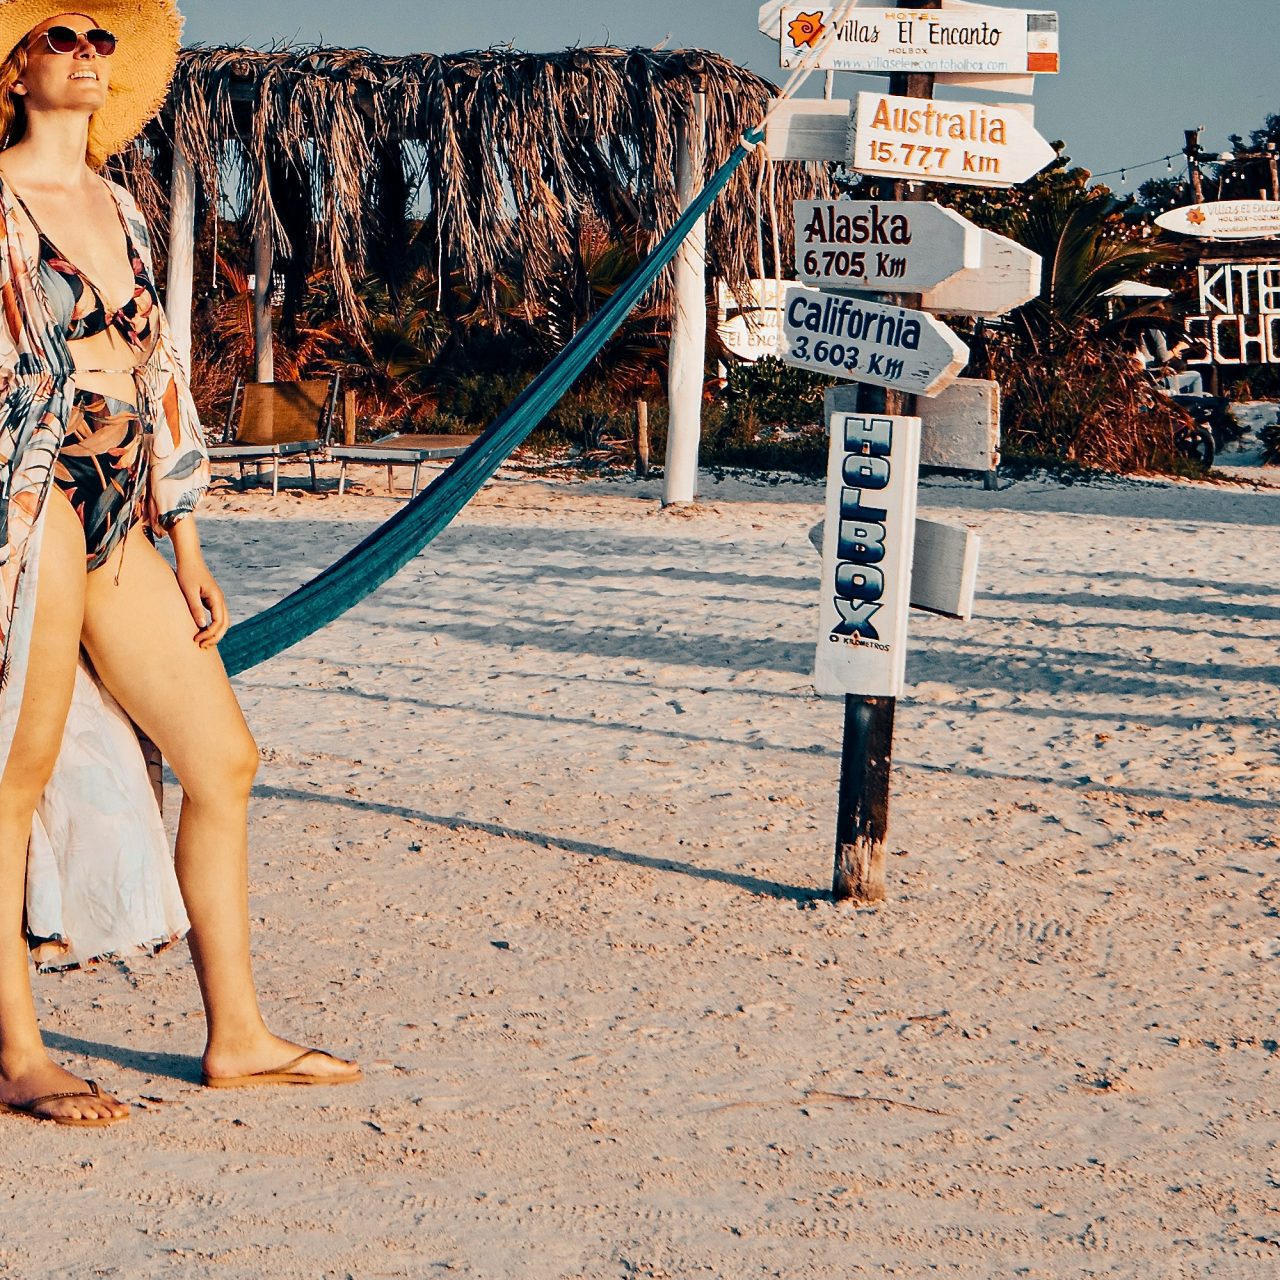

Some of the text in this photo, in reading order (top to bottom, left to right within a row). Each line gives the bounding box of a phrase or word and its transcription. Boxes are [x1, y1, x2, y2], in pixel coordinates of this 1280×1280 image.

[832, 20, 1003, 46] Villas El Encanto
[884, 12, 939, 21] HOTEL
[870, 99, 1007, 146] Australia
[804, 205, 913, 245] Alaska
[804, 250, 866, 278] 6,705
[788, 297, 921, 351] California
[792, 336, 860, 370] 3,603
[831, 417, 893, 640] HOLBOX
